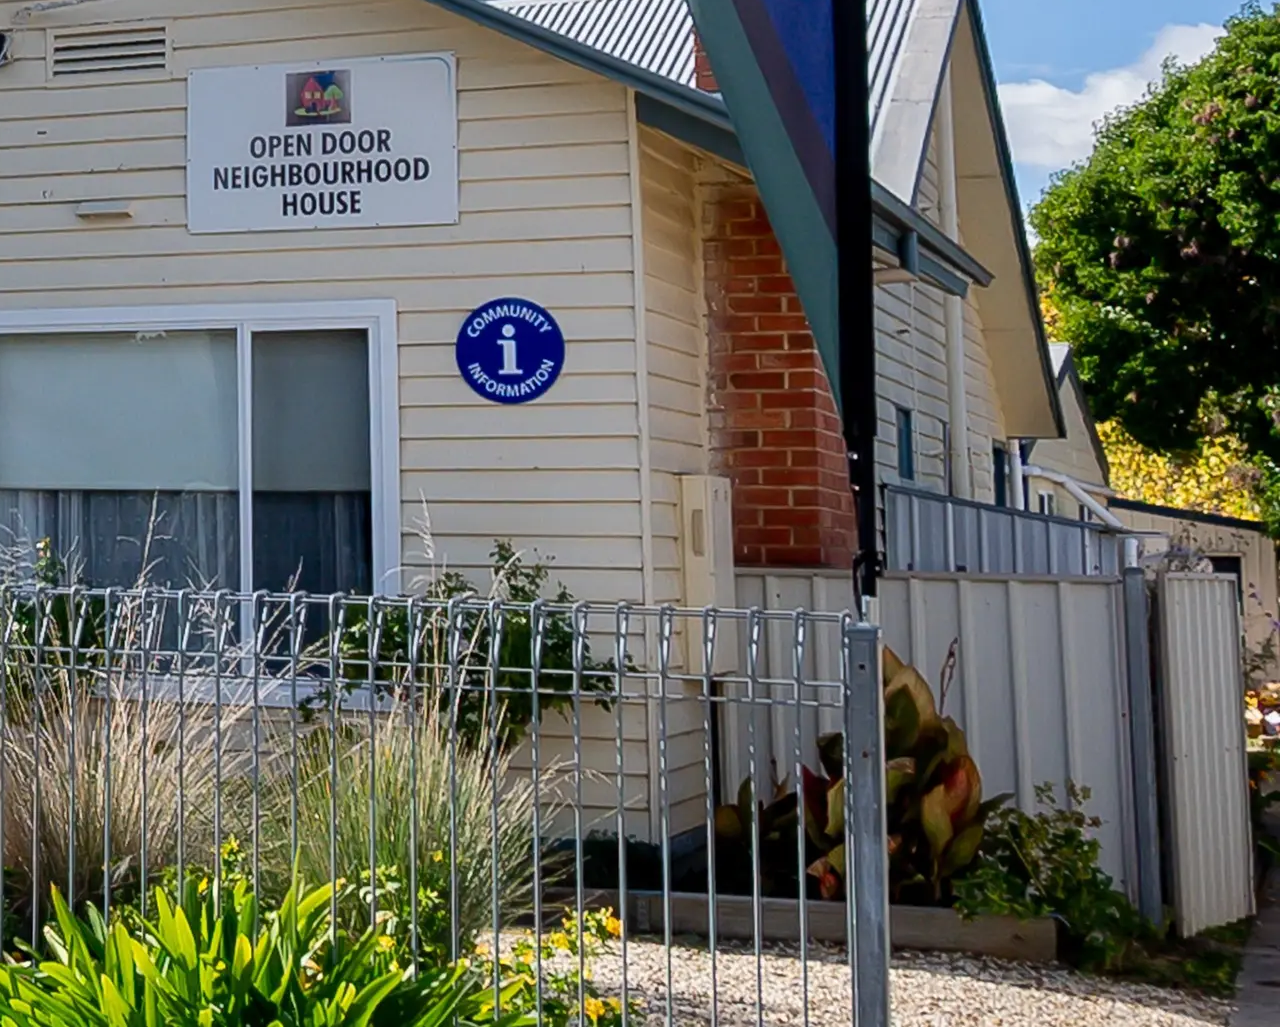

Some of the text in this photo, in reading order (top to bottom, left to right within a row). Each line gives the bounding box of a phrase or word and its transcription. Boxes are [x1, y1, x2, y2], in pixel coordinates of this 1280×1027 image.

[249, 129, 391, 159] OPEN DOOR
[213, 157, 430, 190] NEIGHBOURHOOD
[282, 190, 362, 216] HOUSE
[467, 304, 553, 338] COMMUNITY
[468, 358, 555, 397] INFORMATION
